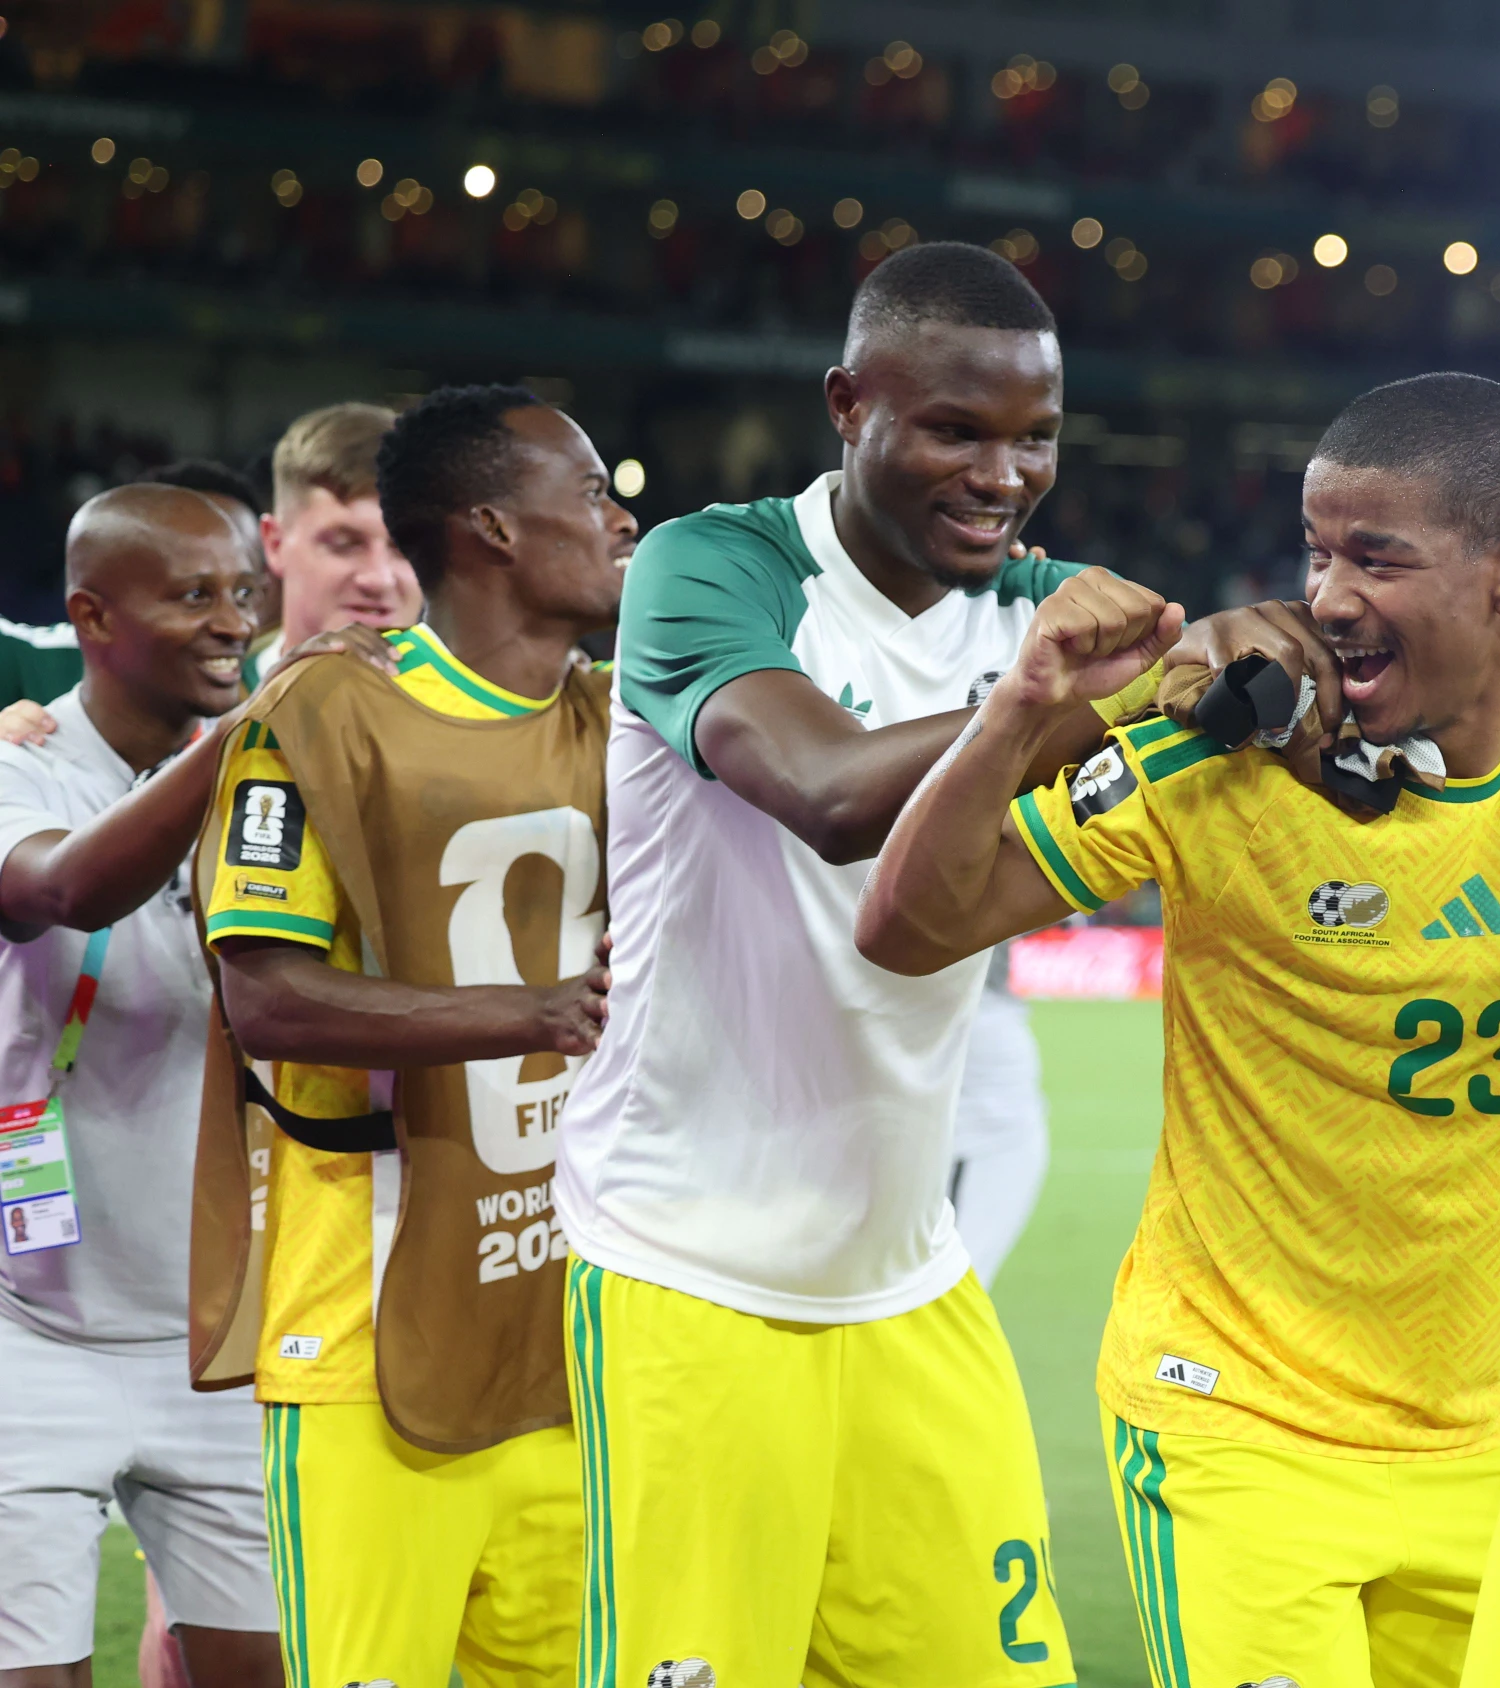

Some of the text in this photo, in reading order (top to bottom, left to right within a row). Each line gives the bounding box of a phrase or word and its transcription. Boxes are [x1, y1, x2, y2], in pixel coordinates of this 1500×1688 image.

[240, 850, 281, 864] 2026
[247, 883, 285, 895] DEBUT
[1312, 928, 1375, 938] SOUTH AFRICAN
[1294, 934, 1390, 946] FOOTBALL ASSOCIATION
[994, 1537, 1056, 1664] 2
